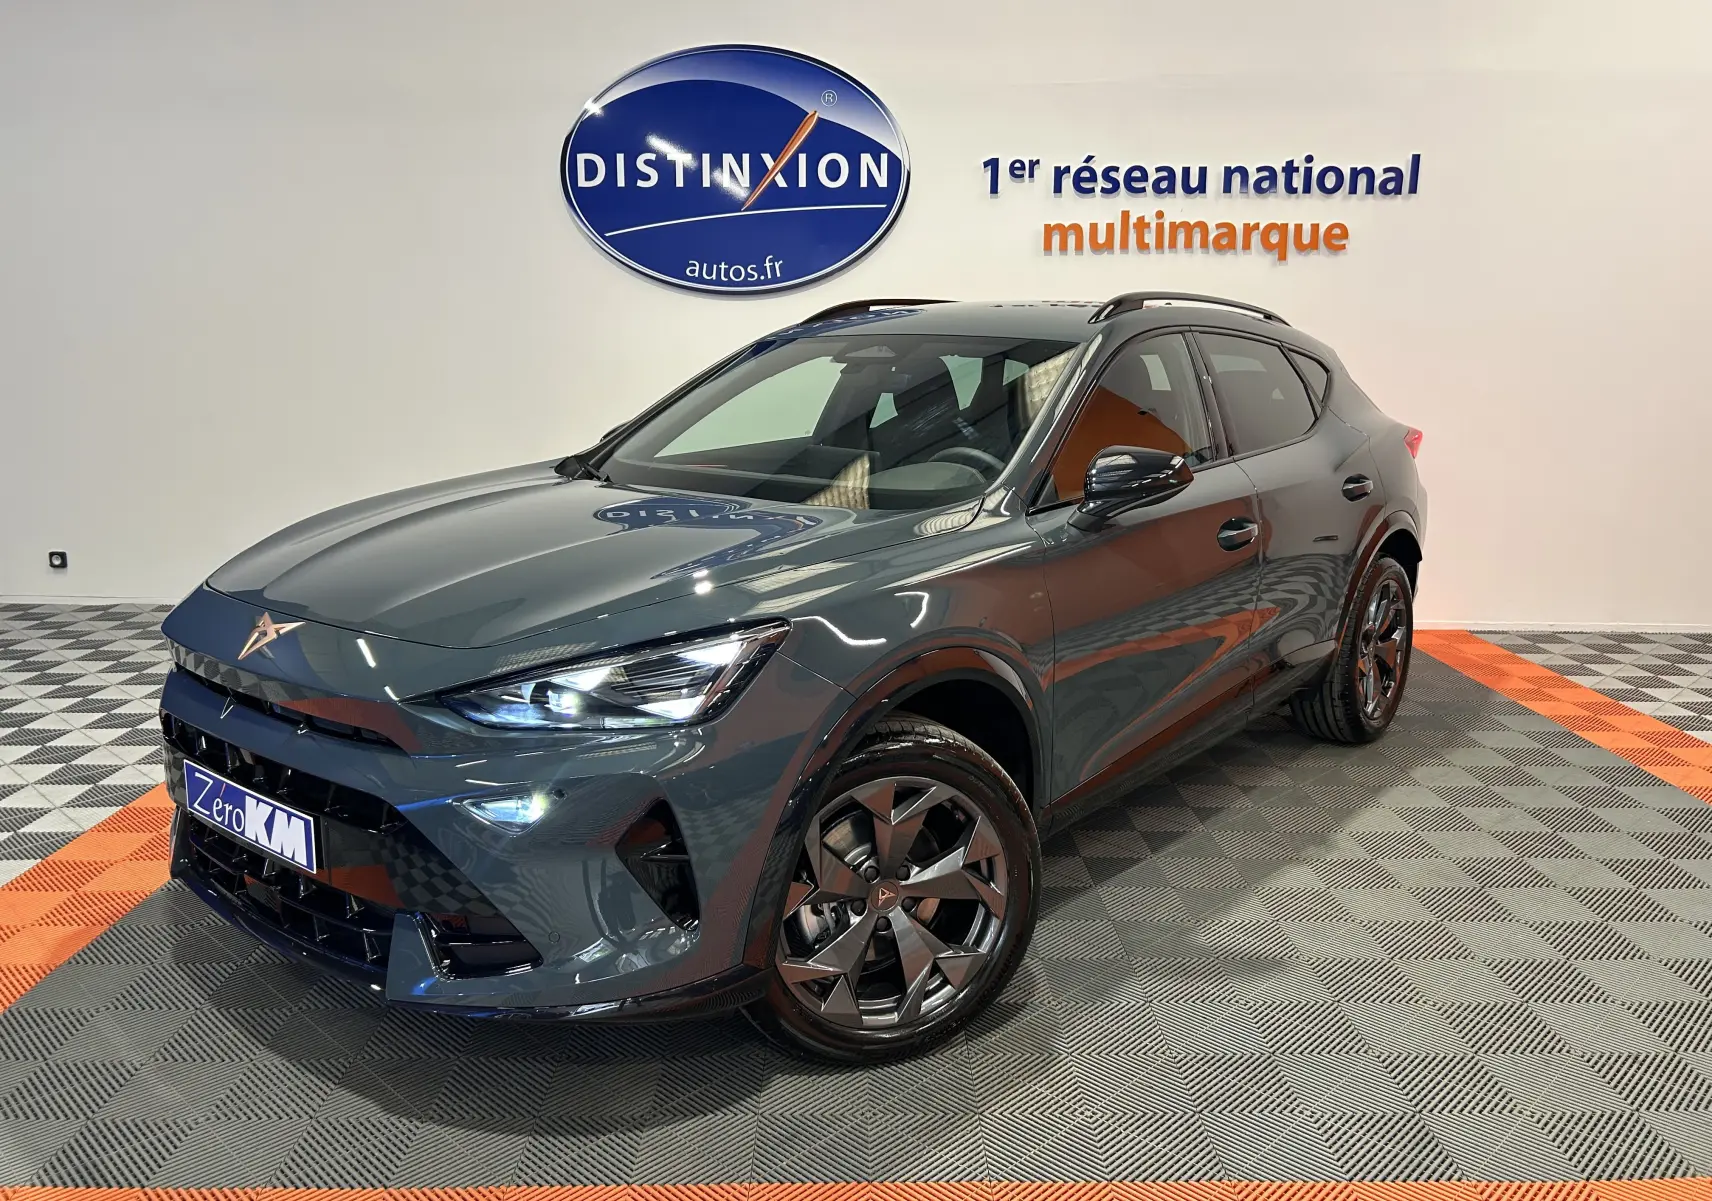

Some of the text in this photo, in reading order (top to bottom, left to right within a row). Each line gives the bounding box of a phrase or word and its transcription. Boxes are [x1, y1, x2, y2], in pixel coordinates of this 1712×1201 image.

[576, 152, 889, 188] DISTINXION
[1052, 154, 1208, 196] réseau
[1221, 153, 1422, 196] national
[1042, 209, 1350, 263] multimarque
[685, 255, 784, 282] autos.fr
